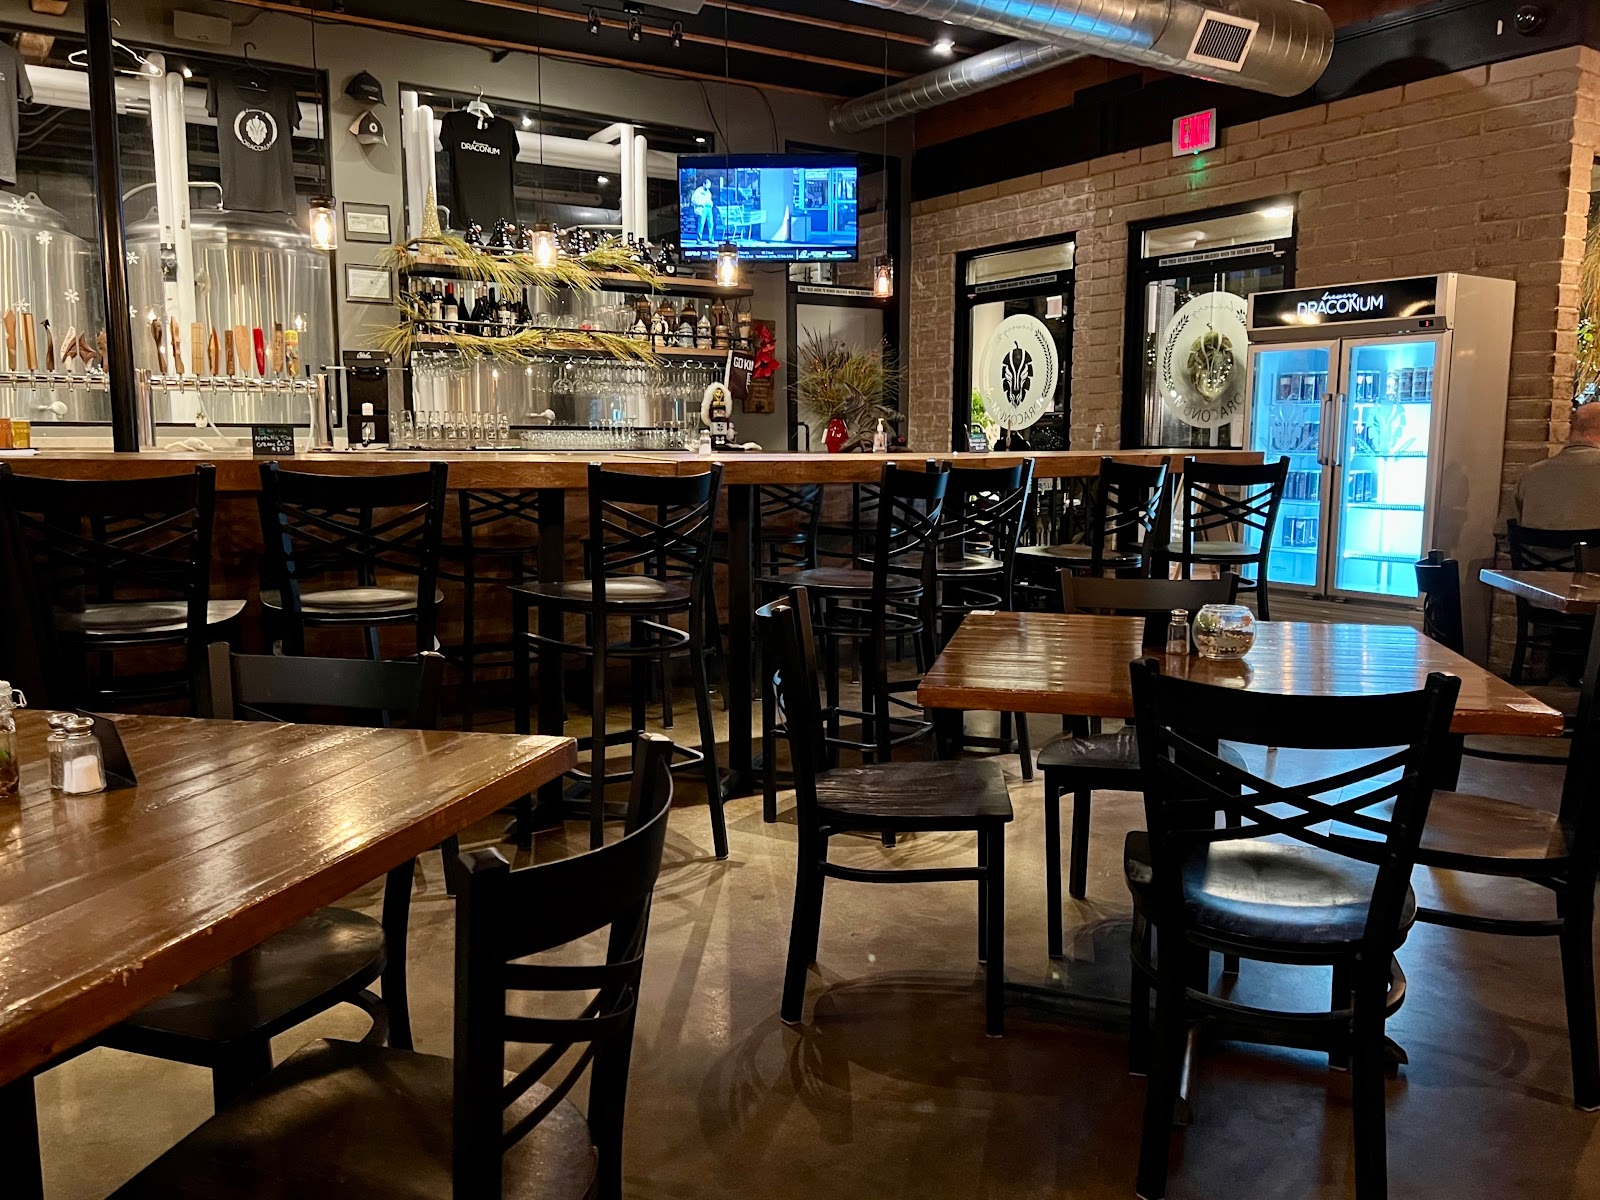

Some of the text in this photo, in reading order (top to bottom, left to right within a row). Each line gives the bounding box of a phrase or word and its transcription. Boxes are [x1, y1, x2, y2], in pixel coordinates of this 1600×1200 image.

[1179, 111, 1211, 150] EXIT
[460, 141, 500, 156] DRACONUM
[1297, 294, 1384, 317] DRACONUM
[733, 356, 744, 369] GO
